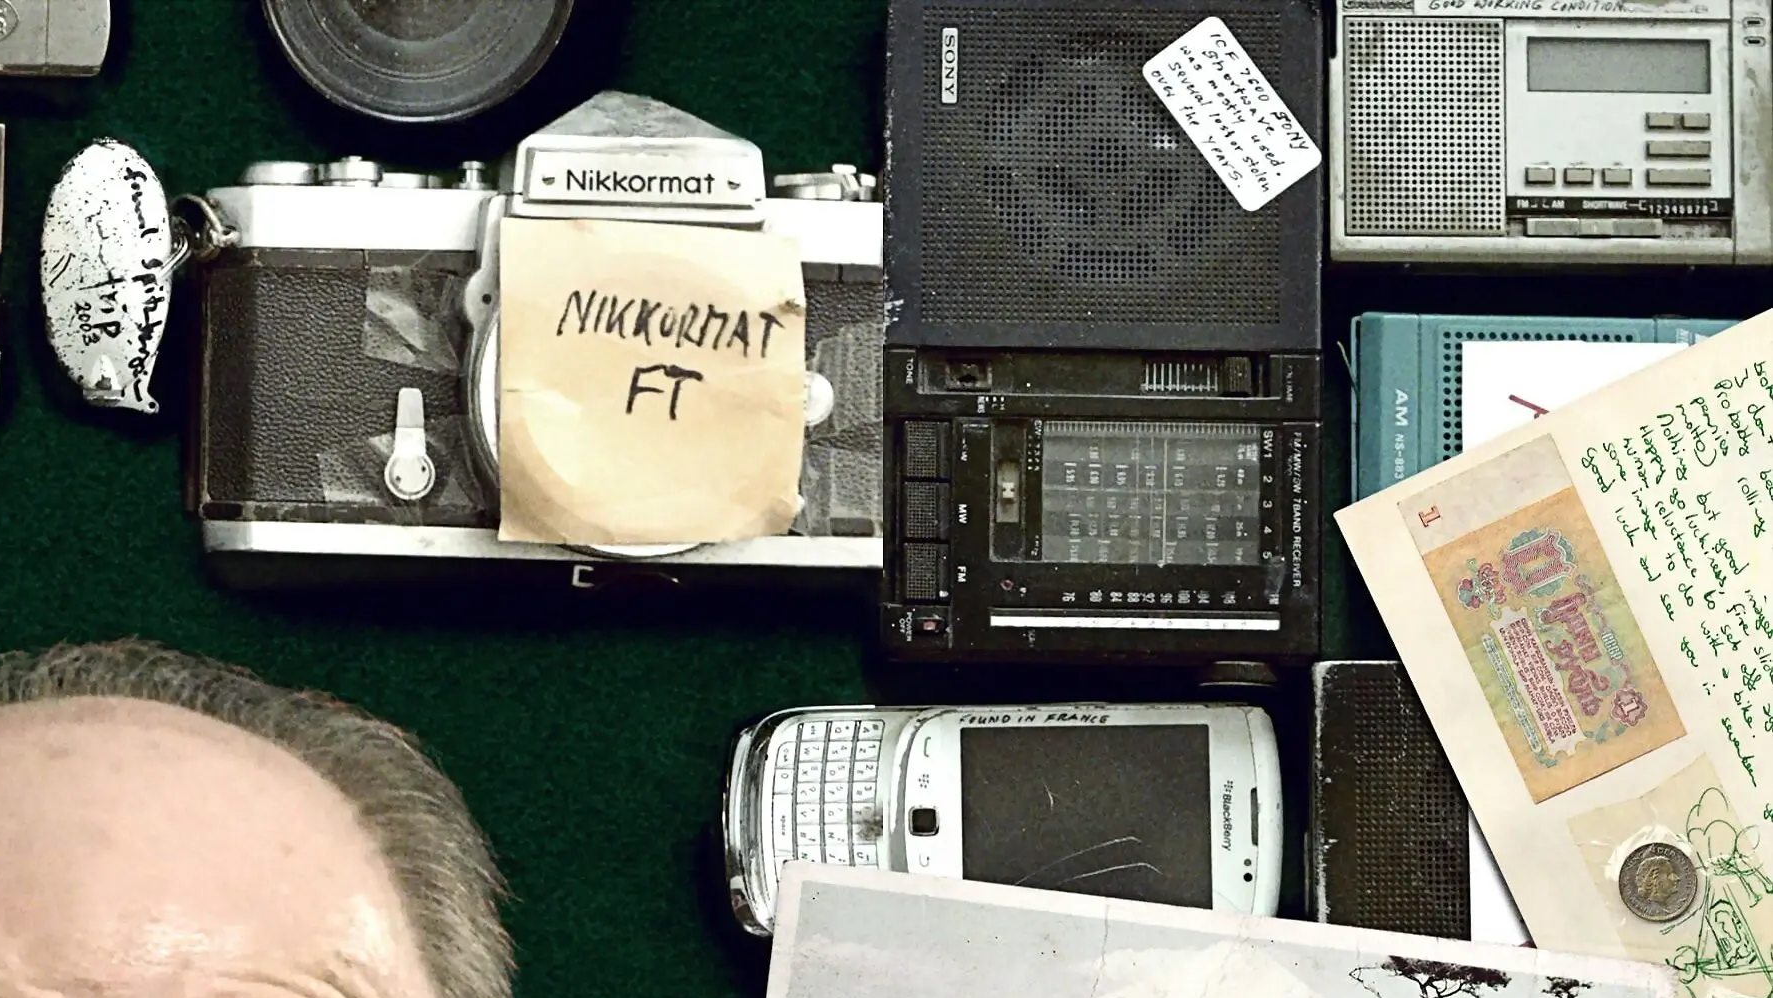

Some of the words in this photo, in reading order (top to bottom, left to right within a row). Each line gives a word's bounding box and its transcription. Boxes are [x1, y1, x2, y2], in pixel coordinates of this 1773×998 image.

[945, 34, 954, 94] SONY
[1180, 48, 1202, 70] was
[1251, 135, 1285, 176] used.
[566, 169, 715, 196] Nikkormat
[1243, 157, 1268, 191] stolen
[1552, 200, 1564, 209] AM
[556, 289, 787, 358] NIKKORMAT
[904, 358, 913, 384] TONE
[625, 364, 704, 421] FT
[1394, 388, 1408, 426] AM
[1714, 380, 1751, 456] Probably
[1262, 430, 1272, 458] SW1
[1640, 426, 1666, 484] Happy
[1670, 488, 1685, 509] go
[1262, 500, 1272, 508] 3
[1657, 414, 1687, 480] Nothing
[1697, 492, 1720, 520] but
[1715, 539, 1749, 575] good
[957, 504, 966, 523] MW
[1262, 526, 1272, 534] 4
[957, 566, 965, 582] FM
[1291, 536, 1301, 586] RECEIVER
[1582, 448, 1615, 493] Good
[1616, 508, 1639, 547] luck
[1640, 558, 1661, 581] and
[1681, 637, 1698, 667] you
[1666, 553, 1675, 571] to
[1678, 583, 1693, 607] do
[1701, 622, 1723, 656] with
[1704, 590, 1716, 609] to
[1044, 710, 1110, 721] FRANCE
